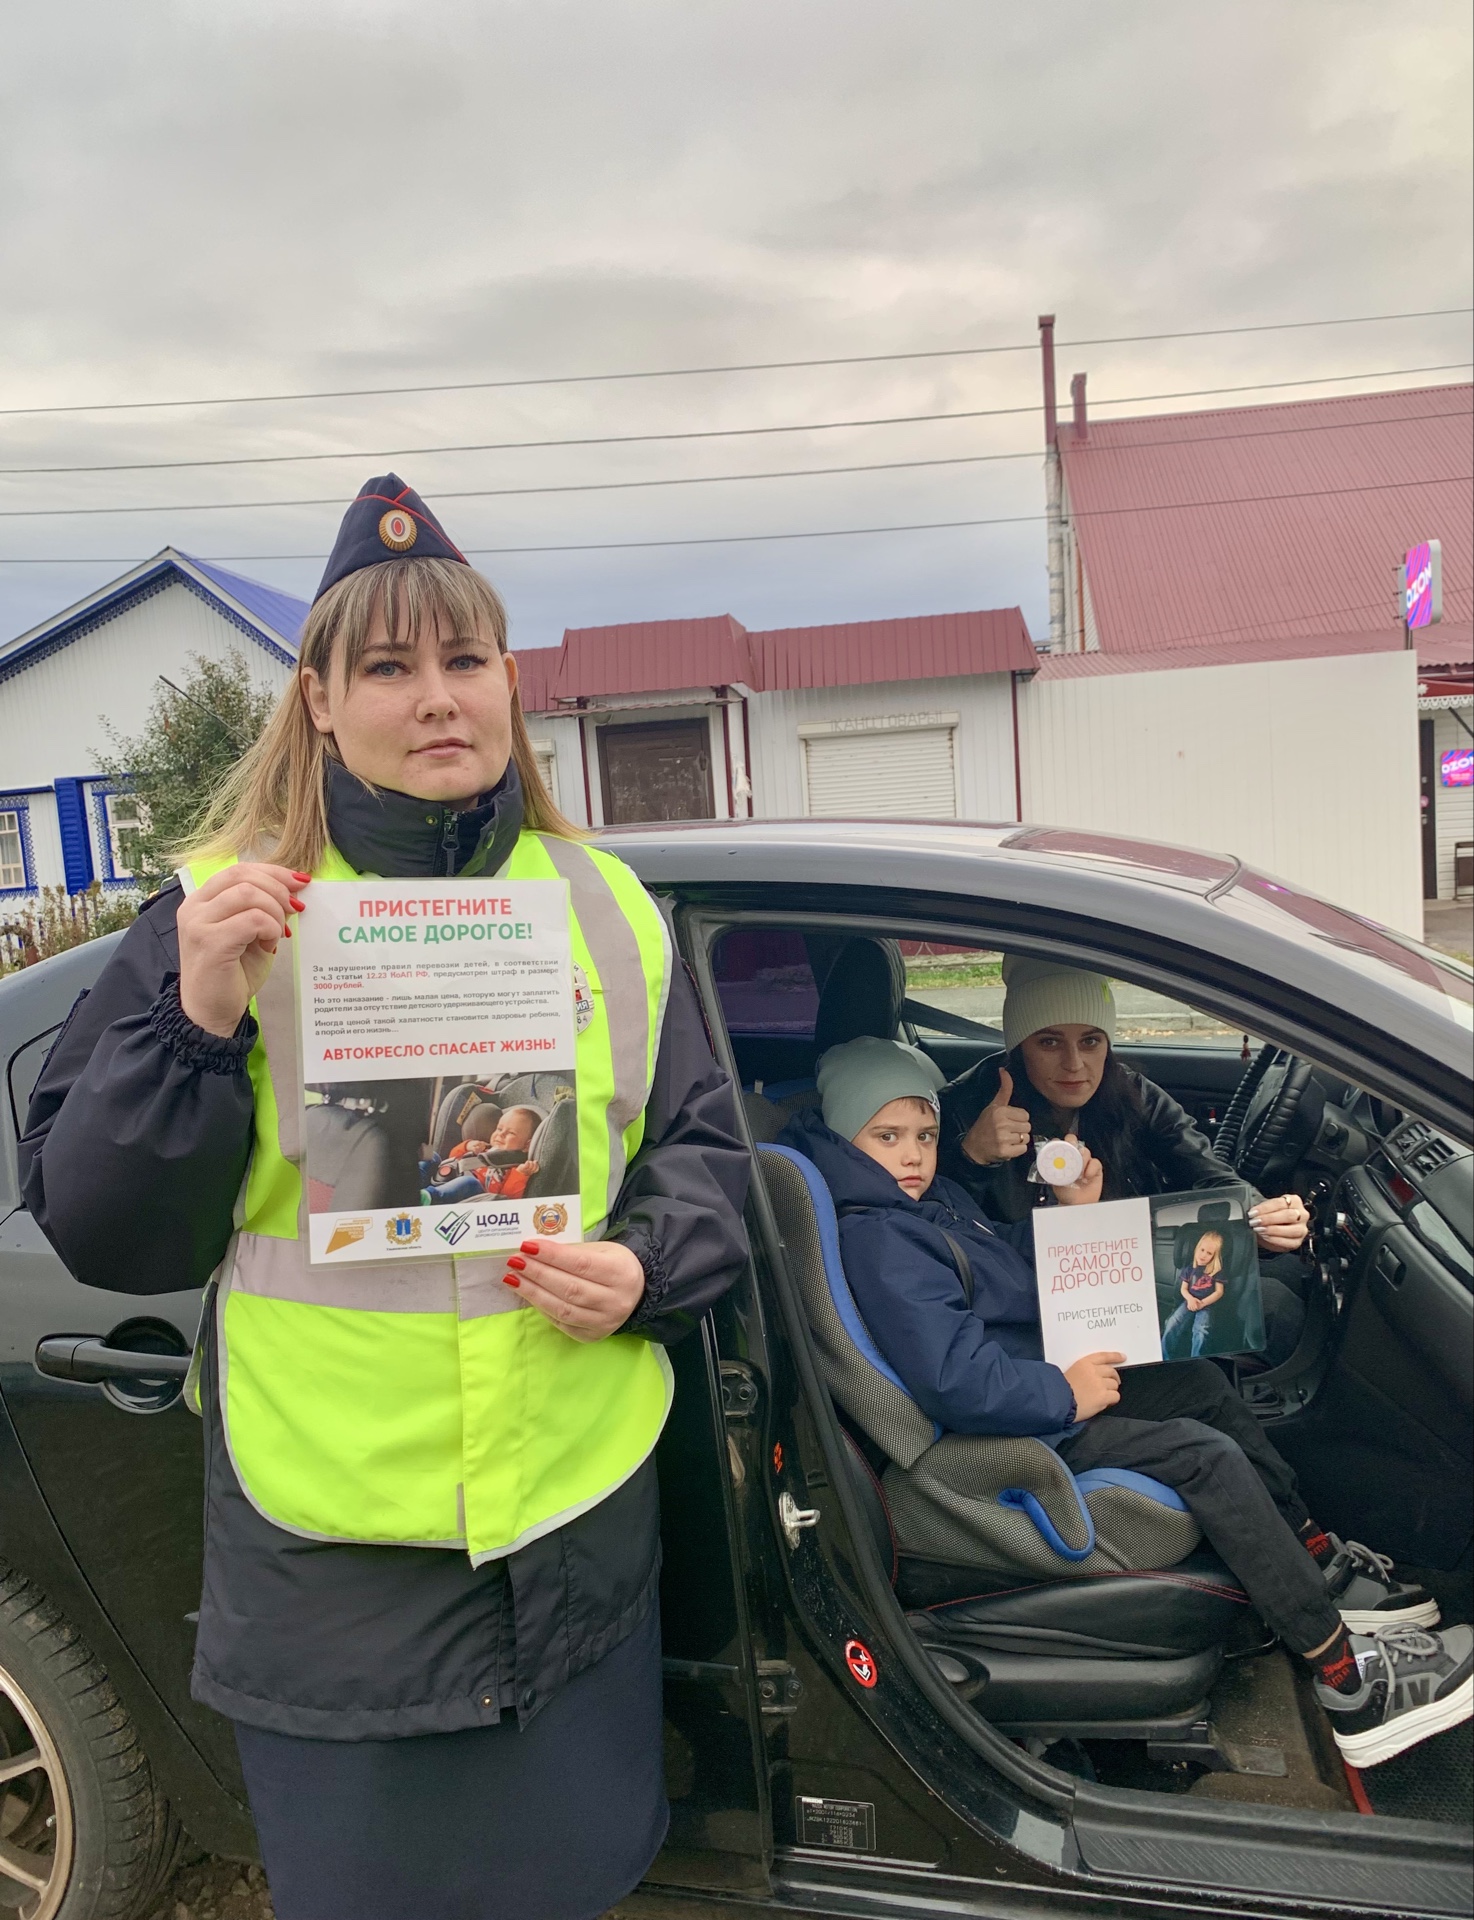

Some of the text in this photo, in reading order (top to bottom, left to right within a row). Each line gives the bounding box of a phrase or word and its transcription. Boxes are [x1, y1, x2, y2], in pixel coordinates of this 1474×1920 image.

[1406, 562, 1431, 609] OZON
[359, 898, 512, 918] ПРИСТЕГНИТЕ
[338, 922, 533, 945] САМОЕ ДОРОГОЕ!
[328, 965, 376, 973] нарушение
[381, 964, 412, 972] правил
[416, 962, 459, 971] перевозки
[464, 960, 490, 969] детей,
[433, 970, 488, 978] предусмотрен
[491, 968, 517, 976] штраф
[333, 982, 364, 990] рублей.
[463, 991, 495, 999] которую
[497, 991, 520, 999] могут
[314, 1006, 353, 1014] родители
[363, 1004, 407, 1012] отсутствие
[408, 1002, 442, 1010] детского
[443, 1000, 504, 1009] удерживающего
[504, 998, 549, 1007] устройства.
[346, 1018, 370, 1026] ценой
[446, 1014, 489, 1022] становится
[529, 1011, 561, 1019] ребенка,
[321, 1027, 345, 1036] порой
[323, 1038, 556, 1061] АВТОКРЕСЛО СПАСАЕТ ЖИЗНЬ!
[476, 1212, 520, 1227] ЦОДД
[1048, 1237, 1139, 1258] ПРИСТЕГНИТЕ
[1059, 1251, 1132, 1273] САМОГО
[1051, 1266, 1143, 1295] ДОРОГОГО
[1057, 1303, 1143, 1322] ПРИСТЕГНИТЕСЬ
[1087, 1317, 1117, 1330] САМИ
